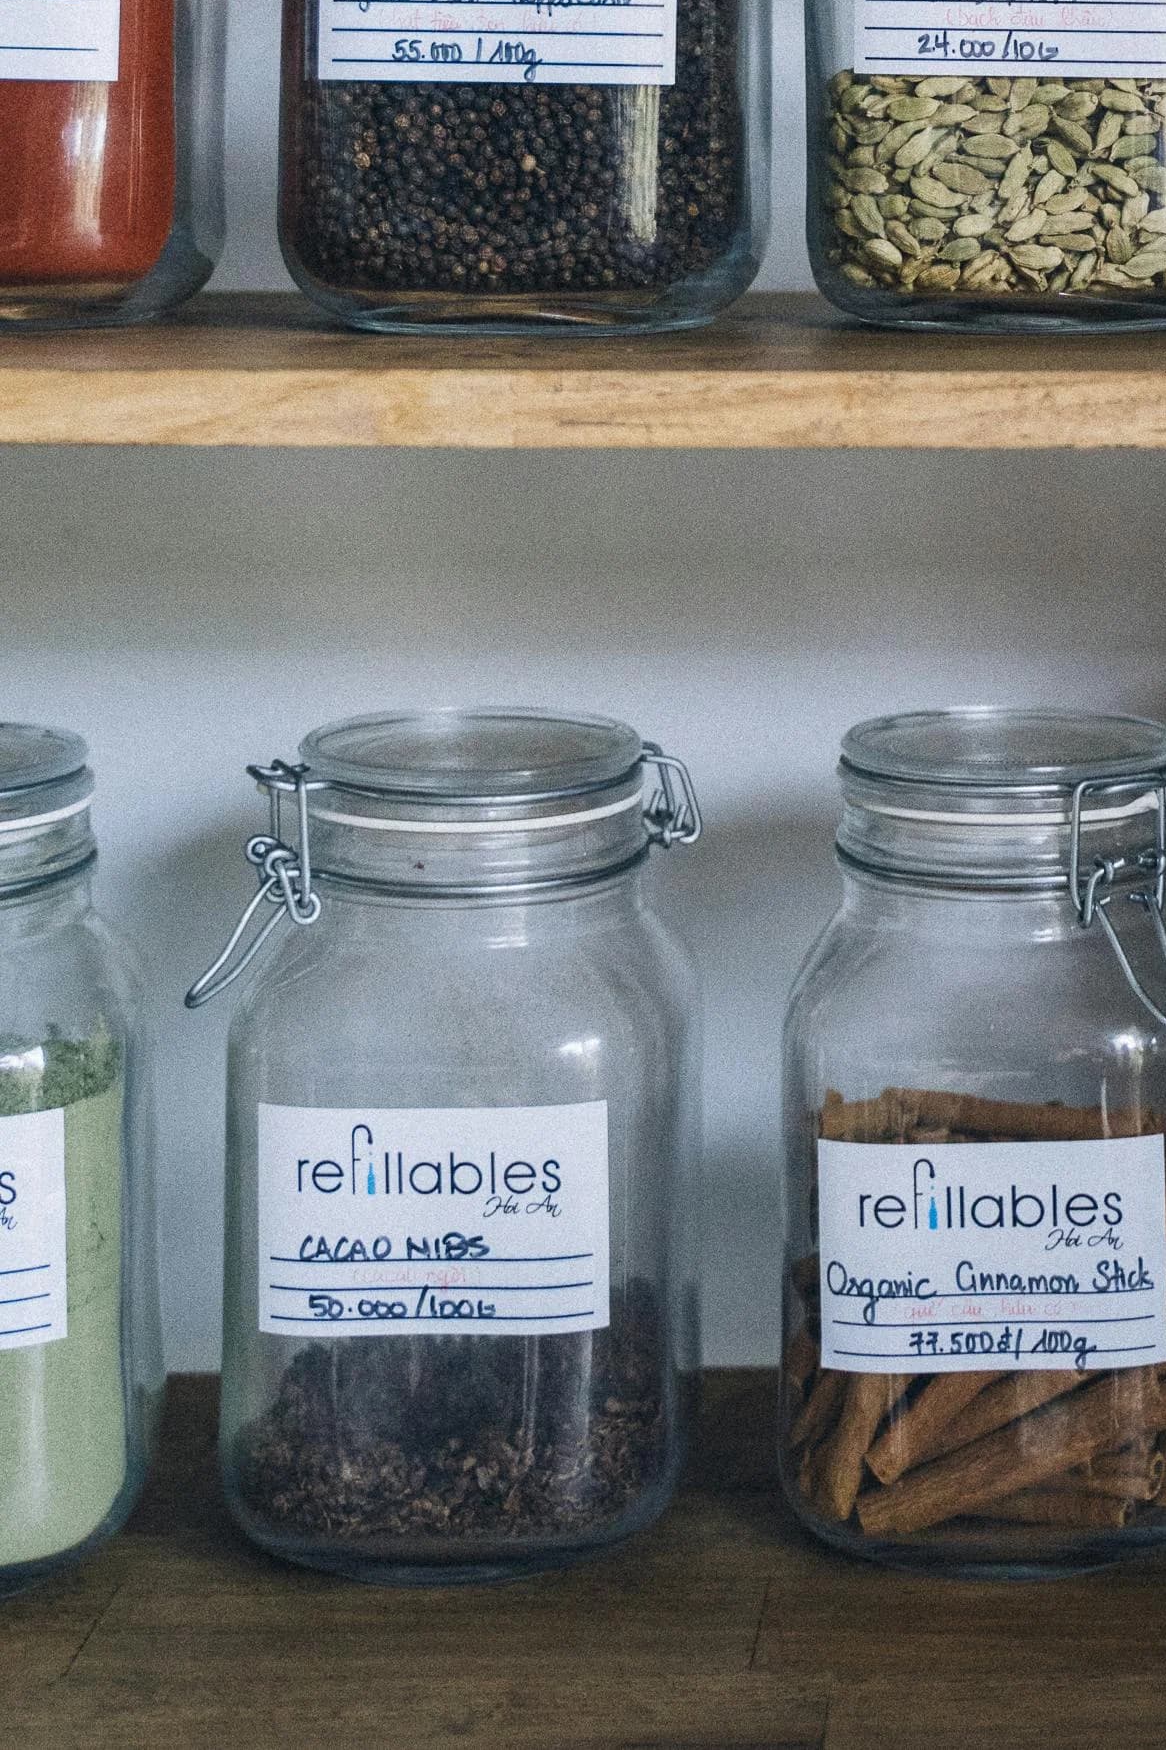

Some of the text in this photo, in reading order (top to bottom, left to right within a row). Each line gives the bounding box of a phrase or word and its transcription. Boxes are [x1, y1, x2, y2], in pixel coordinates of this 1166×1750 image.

[298, 1123, 562, 1195] refillables
[859, 1158, 1123, 1229] refillables
[300, 1231, 491, 1262] CACAO NIBS
[827, 1260, 938, 1324] Organic
[955, 1260, 1079, 1294] Cinnamon
[1092, 1257, 1154, 1292] Stick
